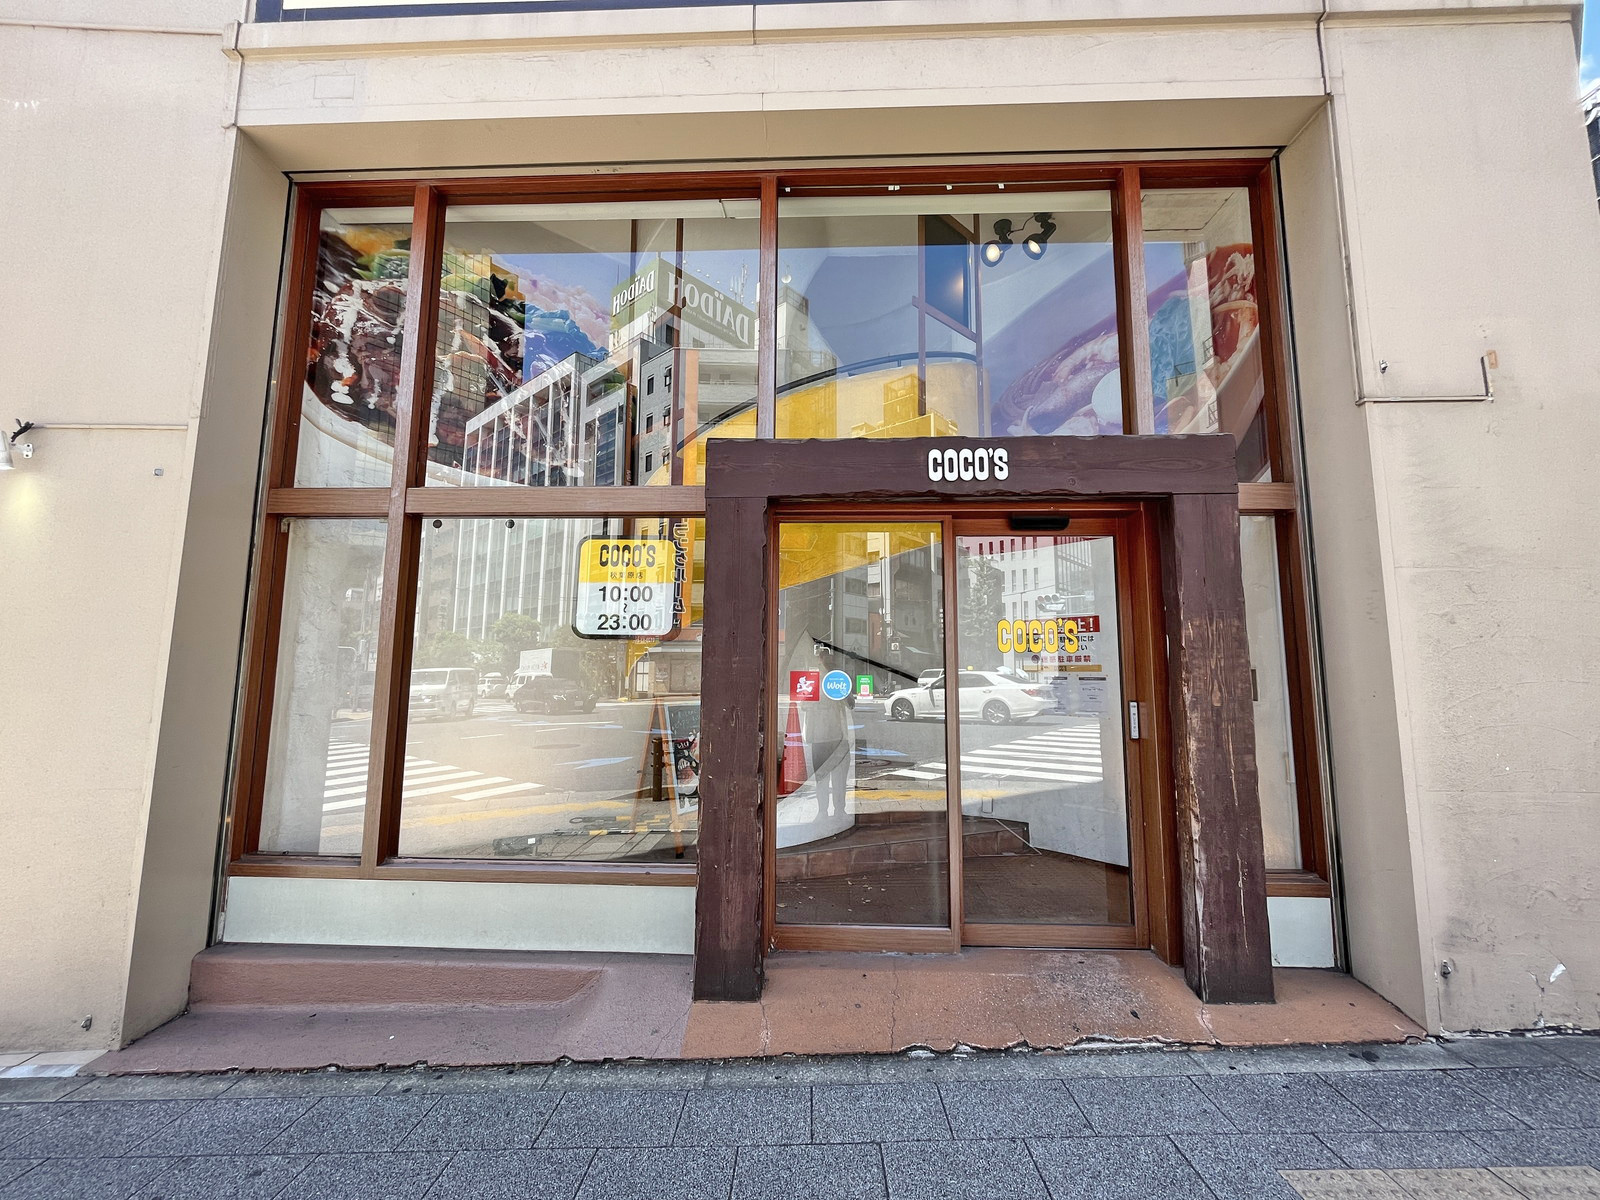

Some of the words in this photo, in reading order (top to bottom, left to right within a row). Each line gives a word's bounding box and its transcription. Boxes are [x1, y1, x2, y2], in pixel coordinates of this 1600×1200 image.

[928, 447, 1009, 482] COCO'S
[599, 543, 656, 568] COCO'S
[598, 585, 653, 602] 10:00
[597, 613, 652, 631] 23:00
[997, 618, 1078, 654] COCO'S
[827, 681, 847, 690] Wolt
